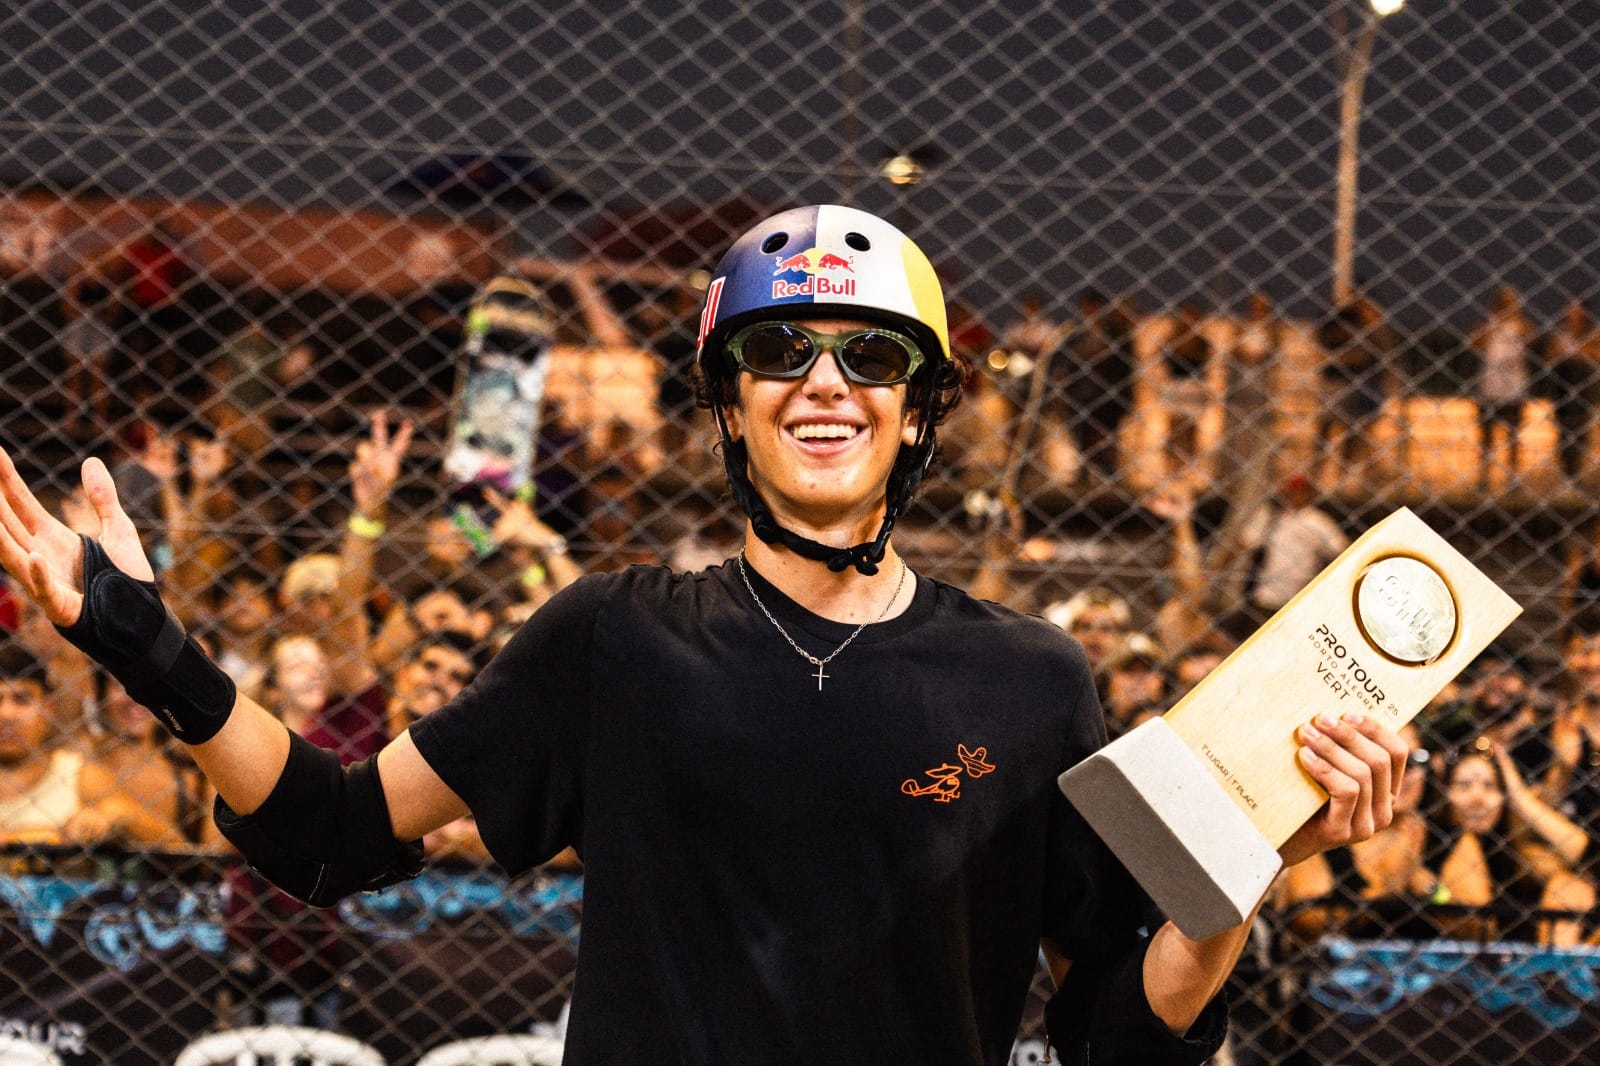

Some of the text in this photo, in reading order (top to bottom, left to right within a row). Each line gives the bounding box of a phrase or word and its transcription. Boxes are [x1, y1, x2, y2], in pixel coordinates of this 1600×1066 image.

[772, 275, 856, 299] Red Bull
[1308, 634, 1375, 712] PORTO ALEGRE
[1316, 623, 1347, 658] PRO
[1347, 657, 1386, 704] TOUR
[1317, 661, 1351, 700] VERT
[1236, 785, 1258, 810] PLACE
